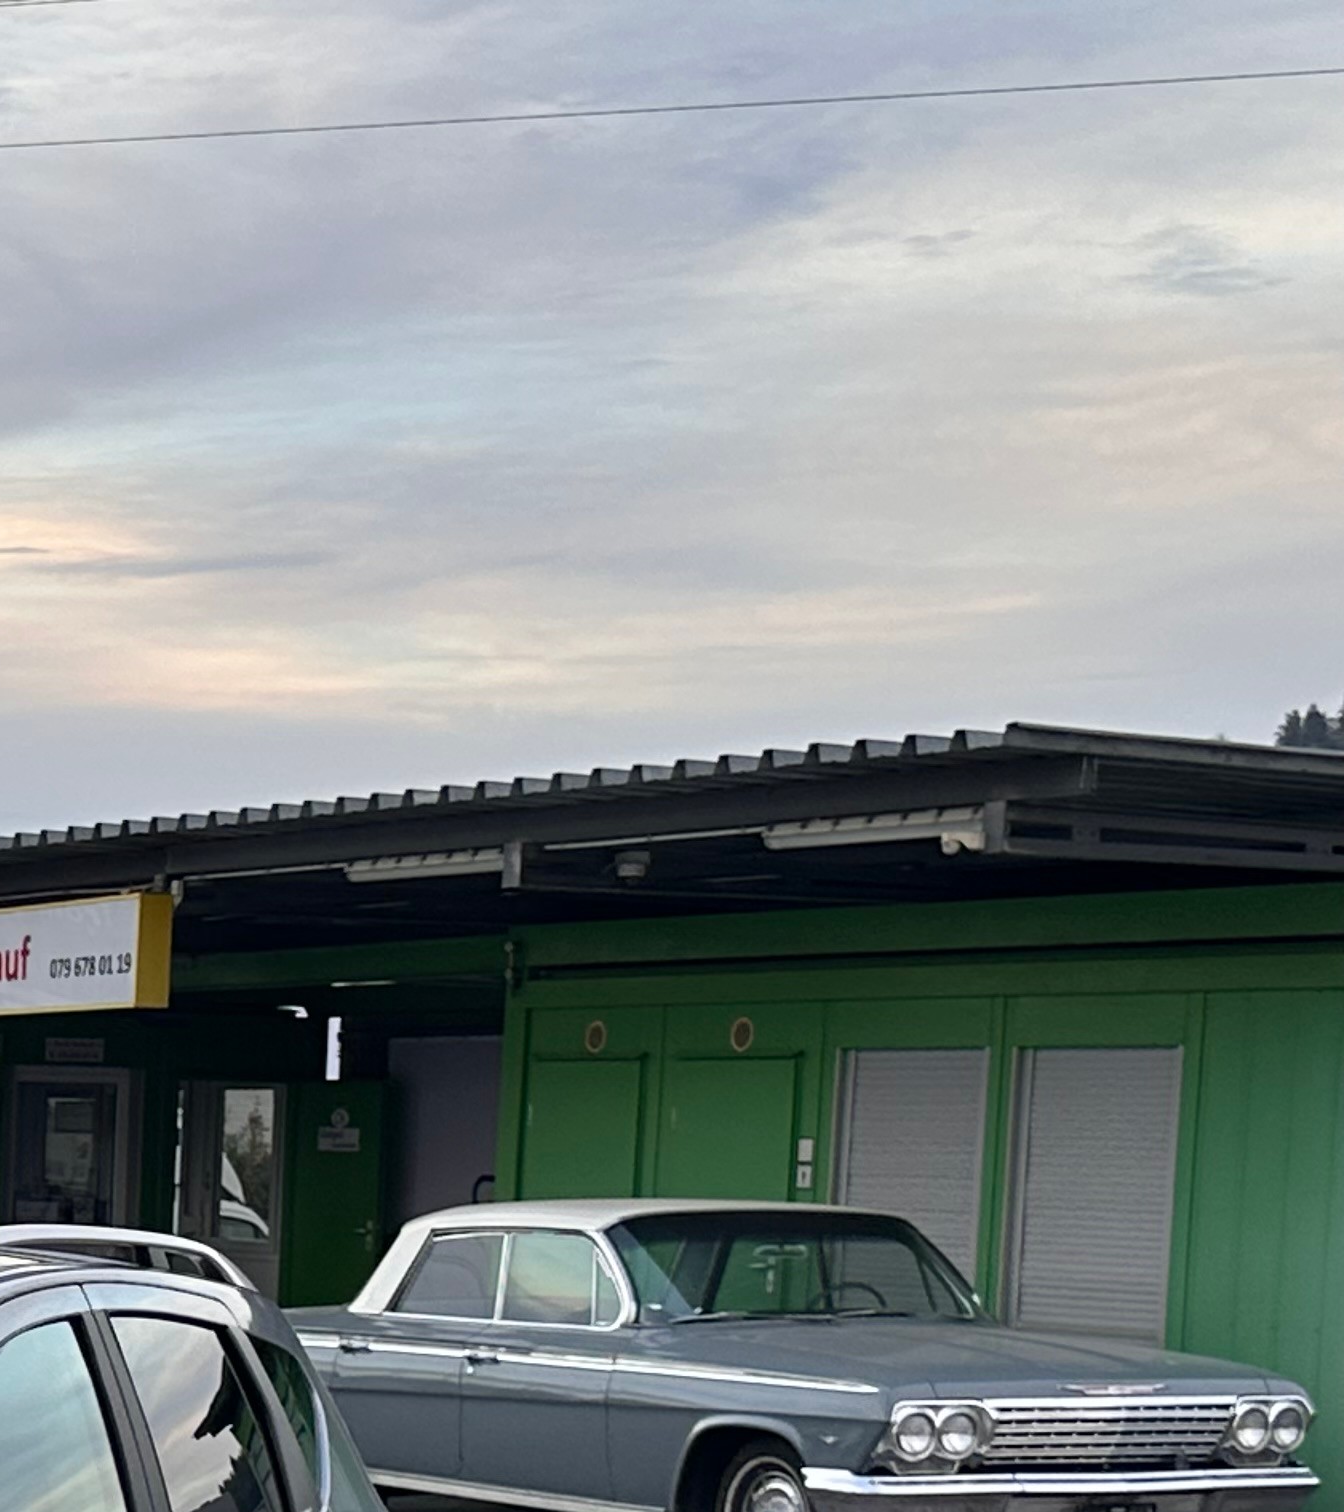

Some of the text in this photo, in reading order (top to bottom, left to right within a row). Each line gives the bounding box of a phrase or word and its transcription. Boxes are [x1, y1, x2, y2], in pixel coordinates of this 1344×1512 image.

[49, 952, 132, 979] 079 678 01 19
